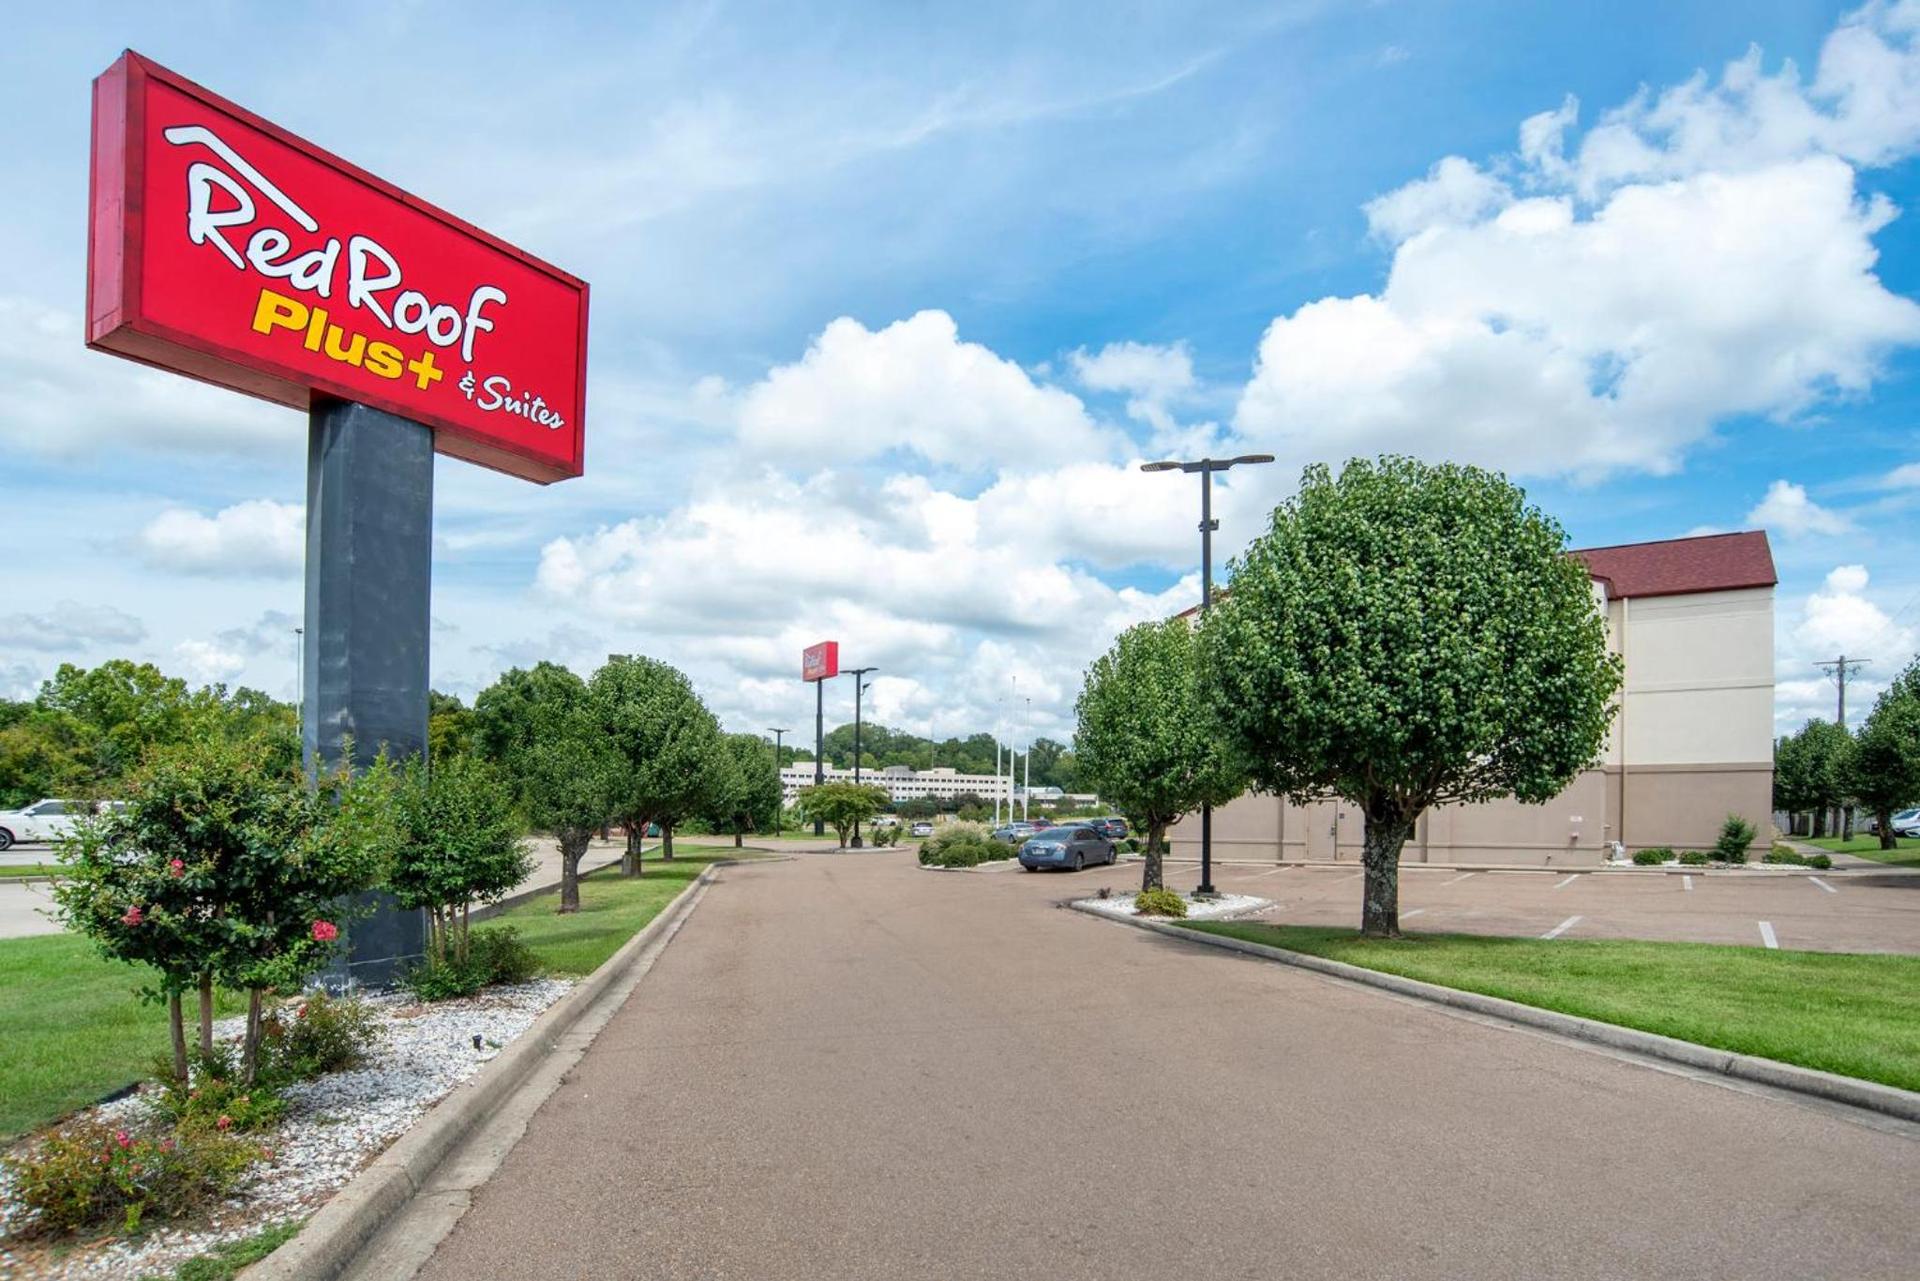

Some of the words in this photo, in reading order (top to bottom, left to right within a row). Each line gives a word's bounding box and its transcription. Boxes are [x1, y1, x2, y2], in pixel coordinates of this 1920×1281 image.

[188, 162, 341, 298] Red
[348, 235, 507, 362] Roof
[252, 288, 443, 390] Plus+
[458, 370, 476, 400] &
[477, 376, 565, 429] Suites
